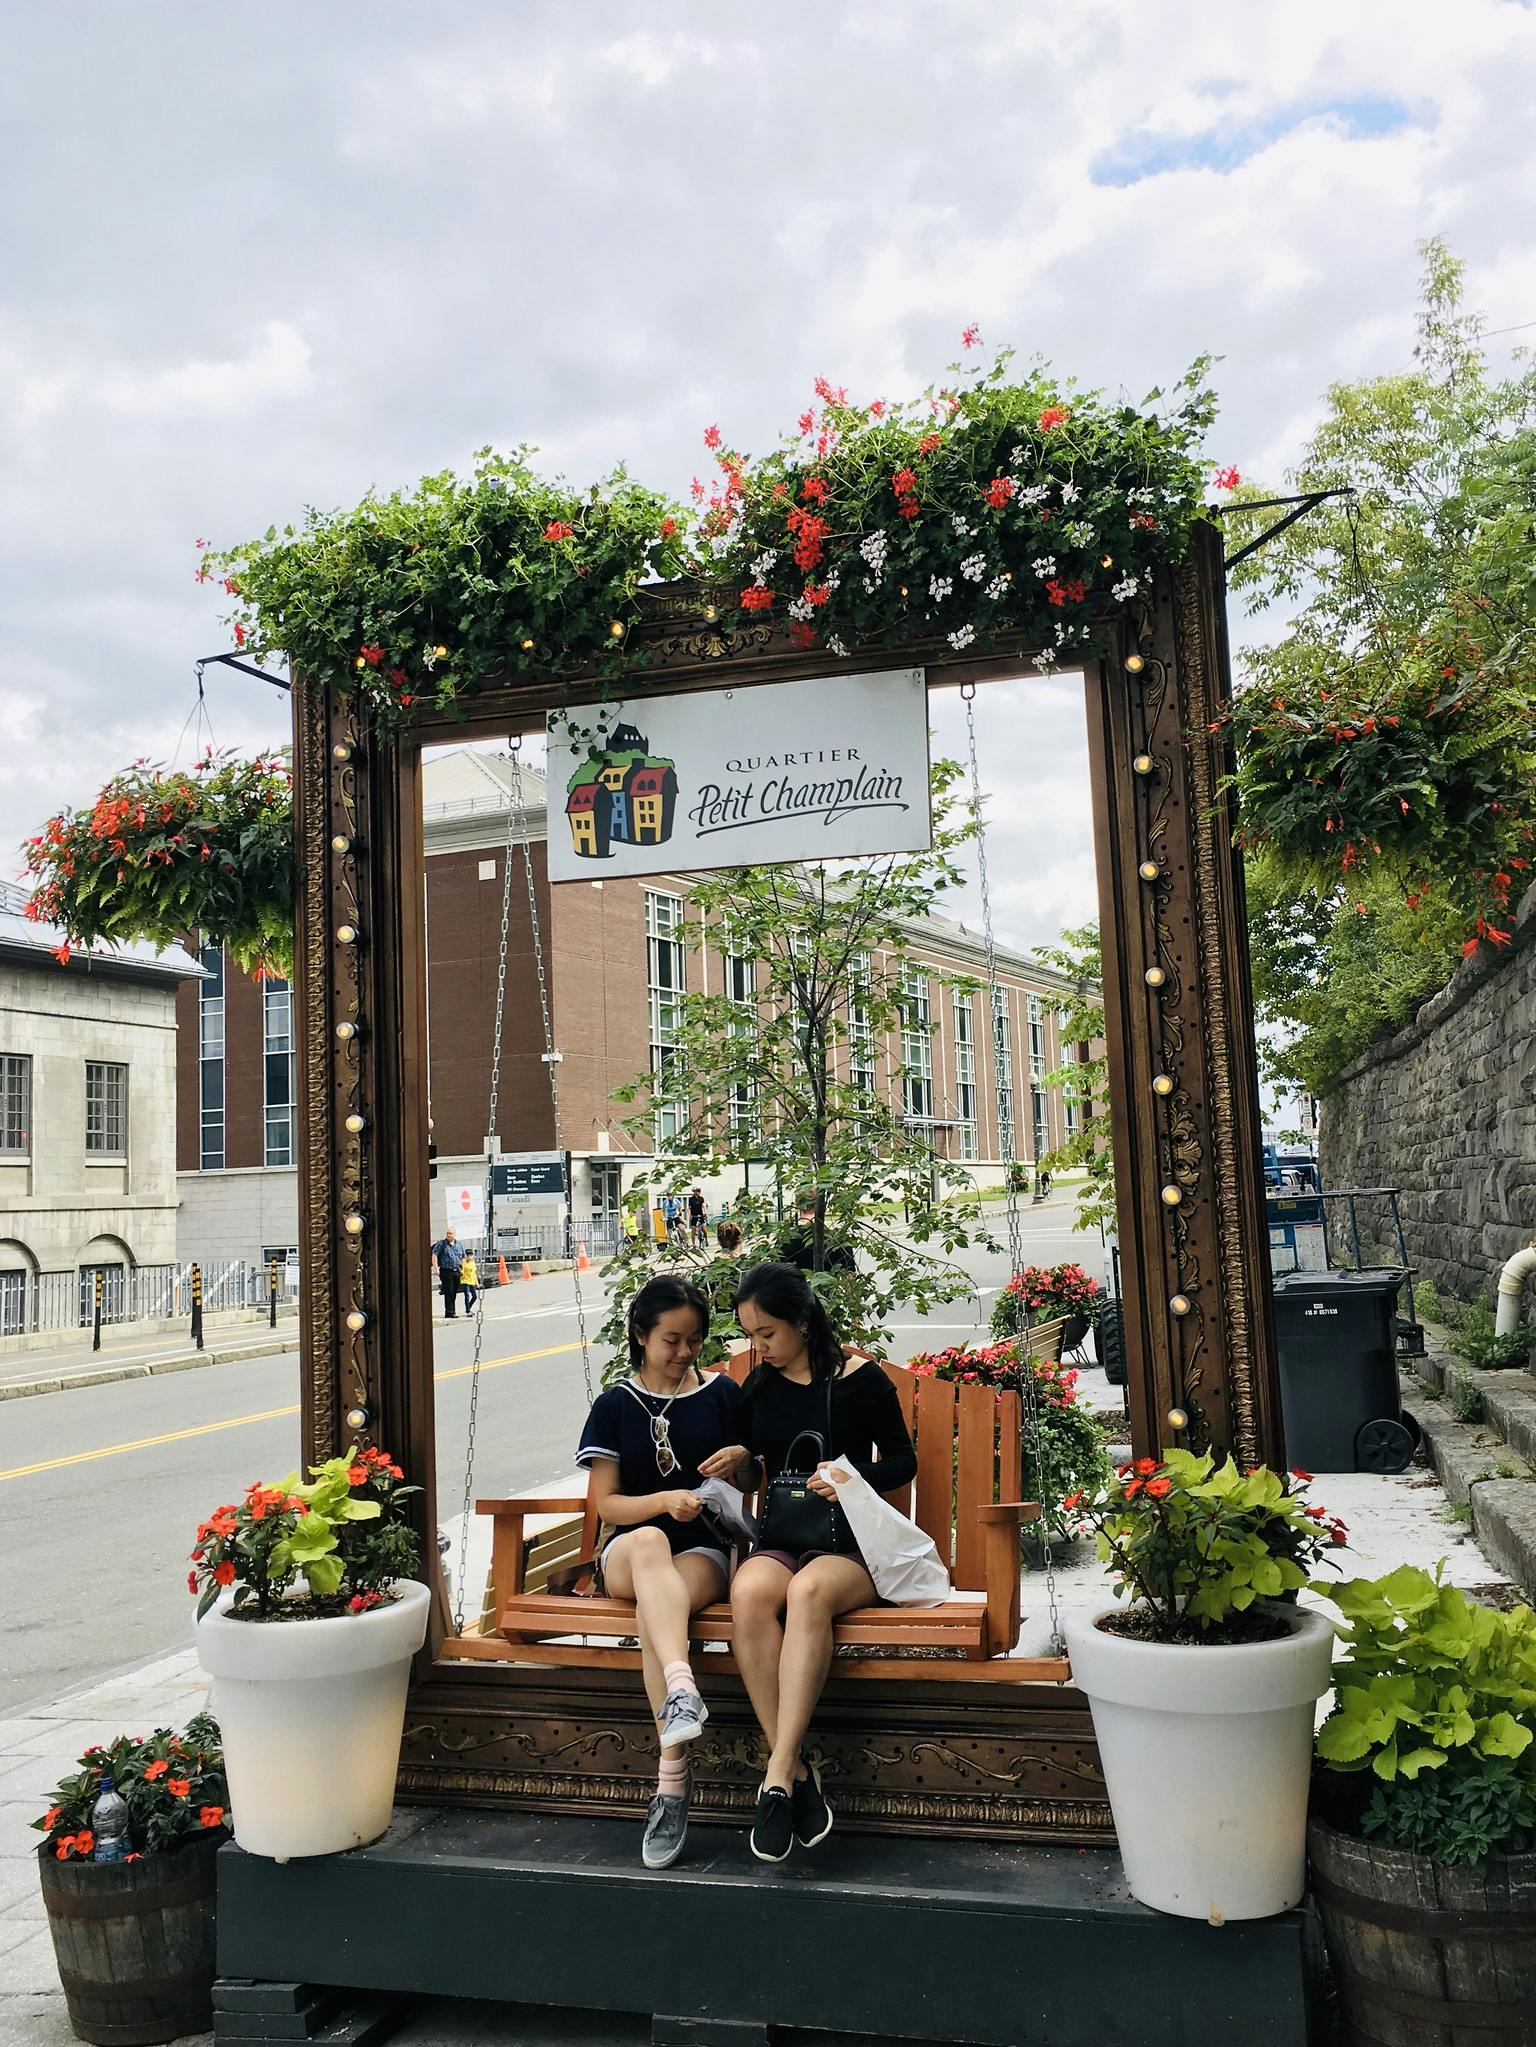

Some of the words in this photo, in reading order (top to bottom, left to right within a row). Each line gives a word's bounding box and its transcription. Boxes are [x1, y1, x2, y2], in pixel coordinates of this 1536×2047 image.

[725, 748, 861, 773] QUARTIER
[689, 781, 754, 828] Petit
[759, 765, 903, 826] Champlain
